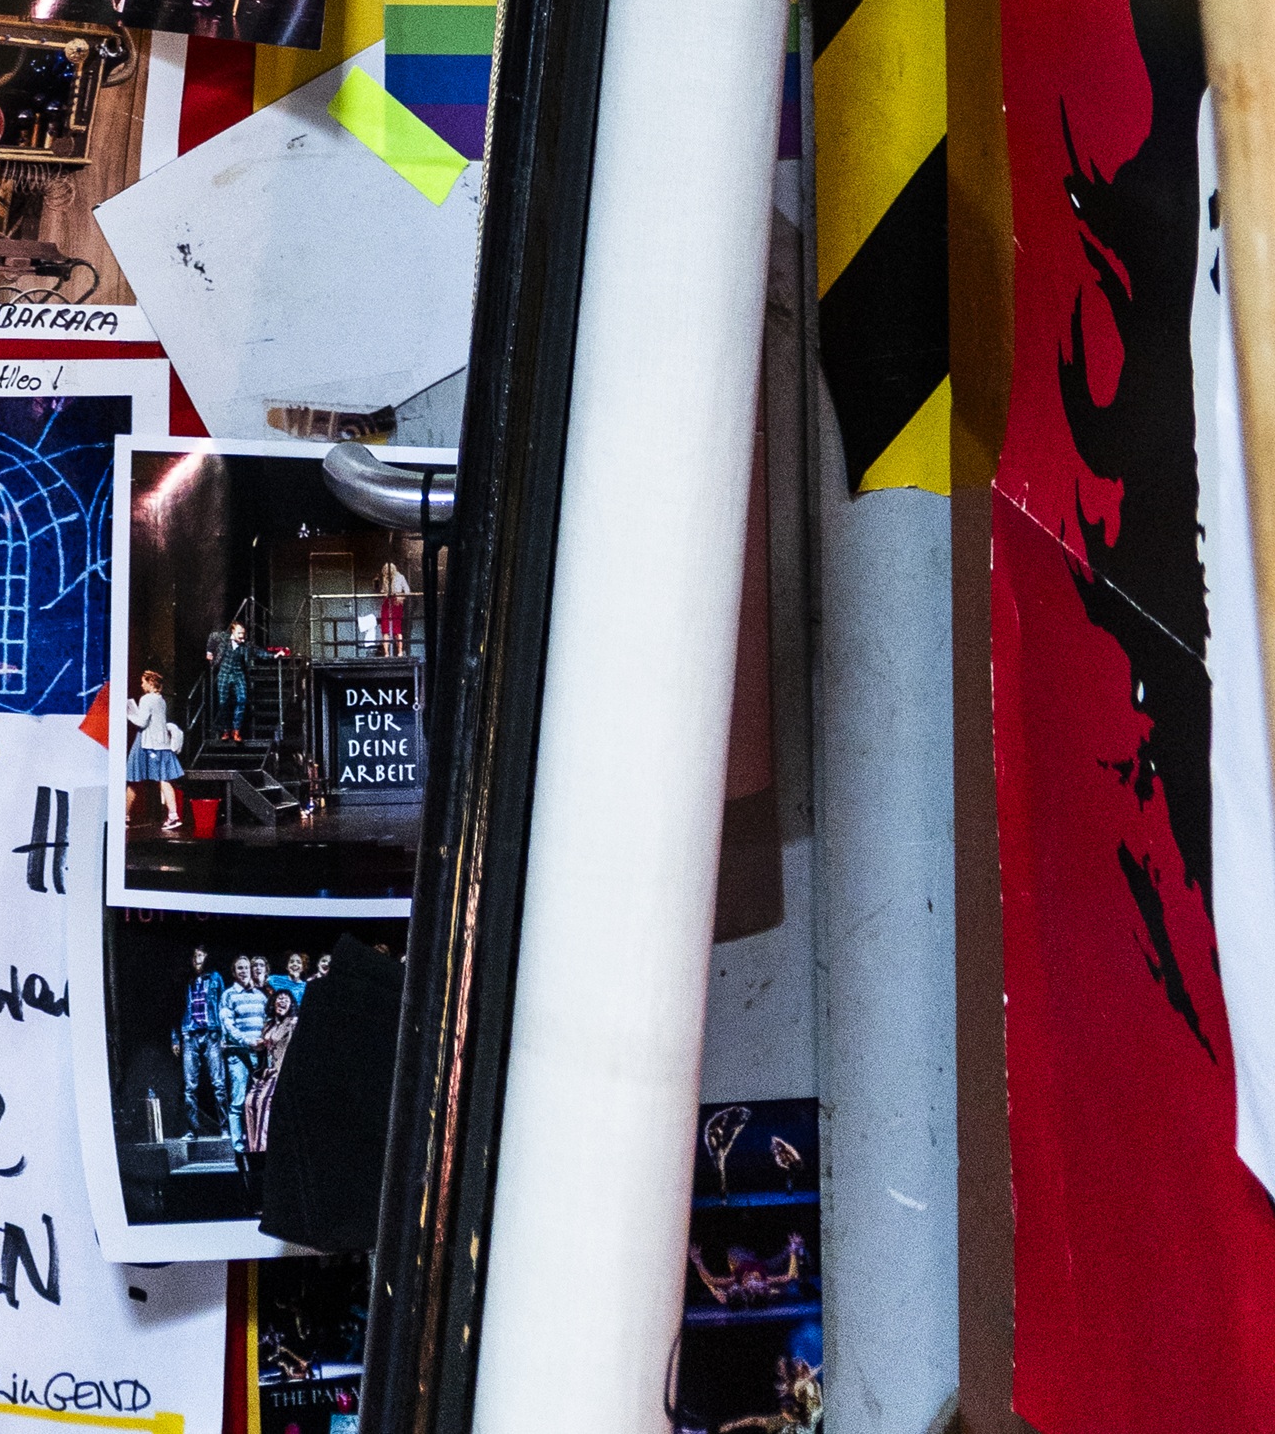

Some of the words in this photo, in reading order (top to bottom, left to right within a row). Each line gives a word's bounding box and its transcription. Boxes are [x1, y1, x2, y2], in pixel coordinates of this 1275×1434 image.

[346, 689, 408, 706] DANK
[355, 711, 402, 733] FÜR
[348, 739, 408, 757] DEINE
[340, 764, 416, 783] ARBEIT
